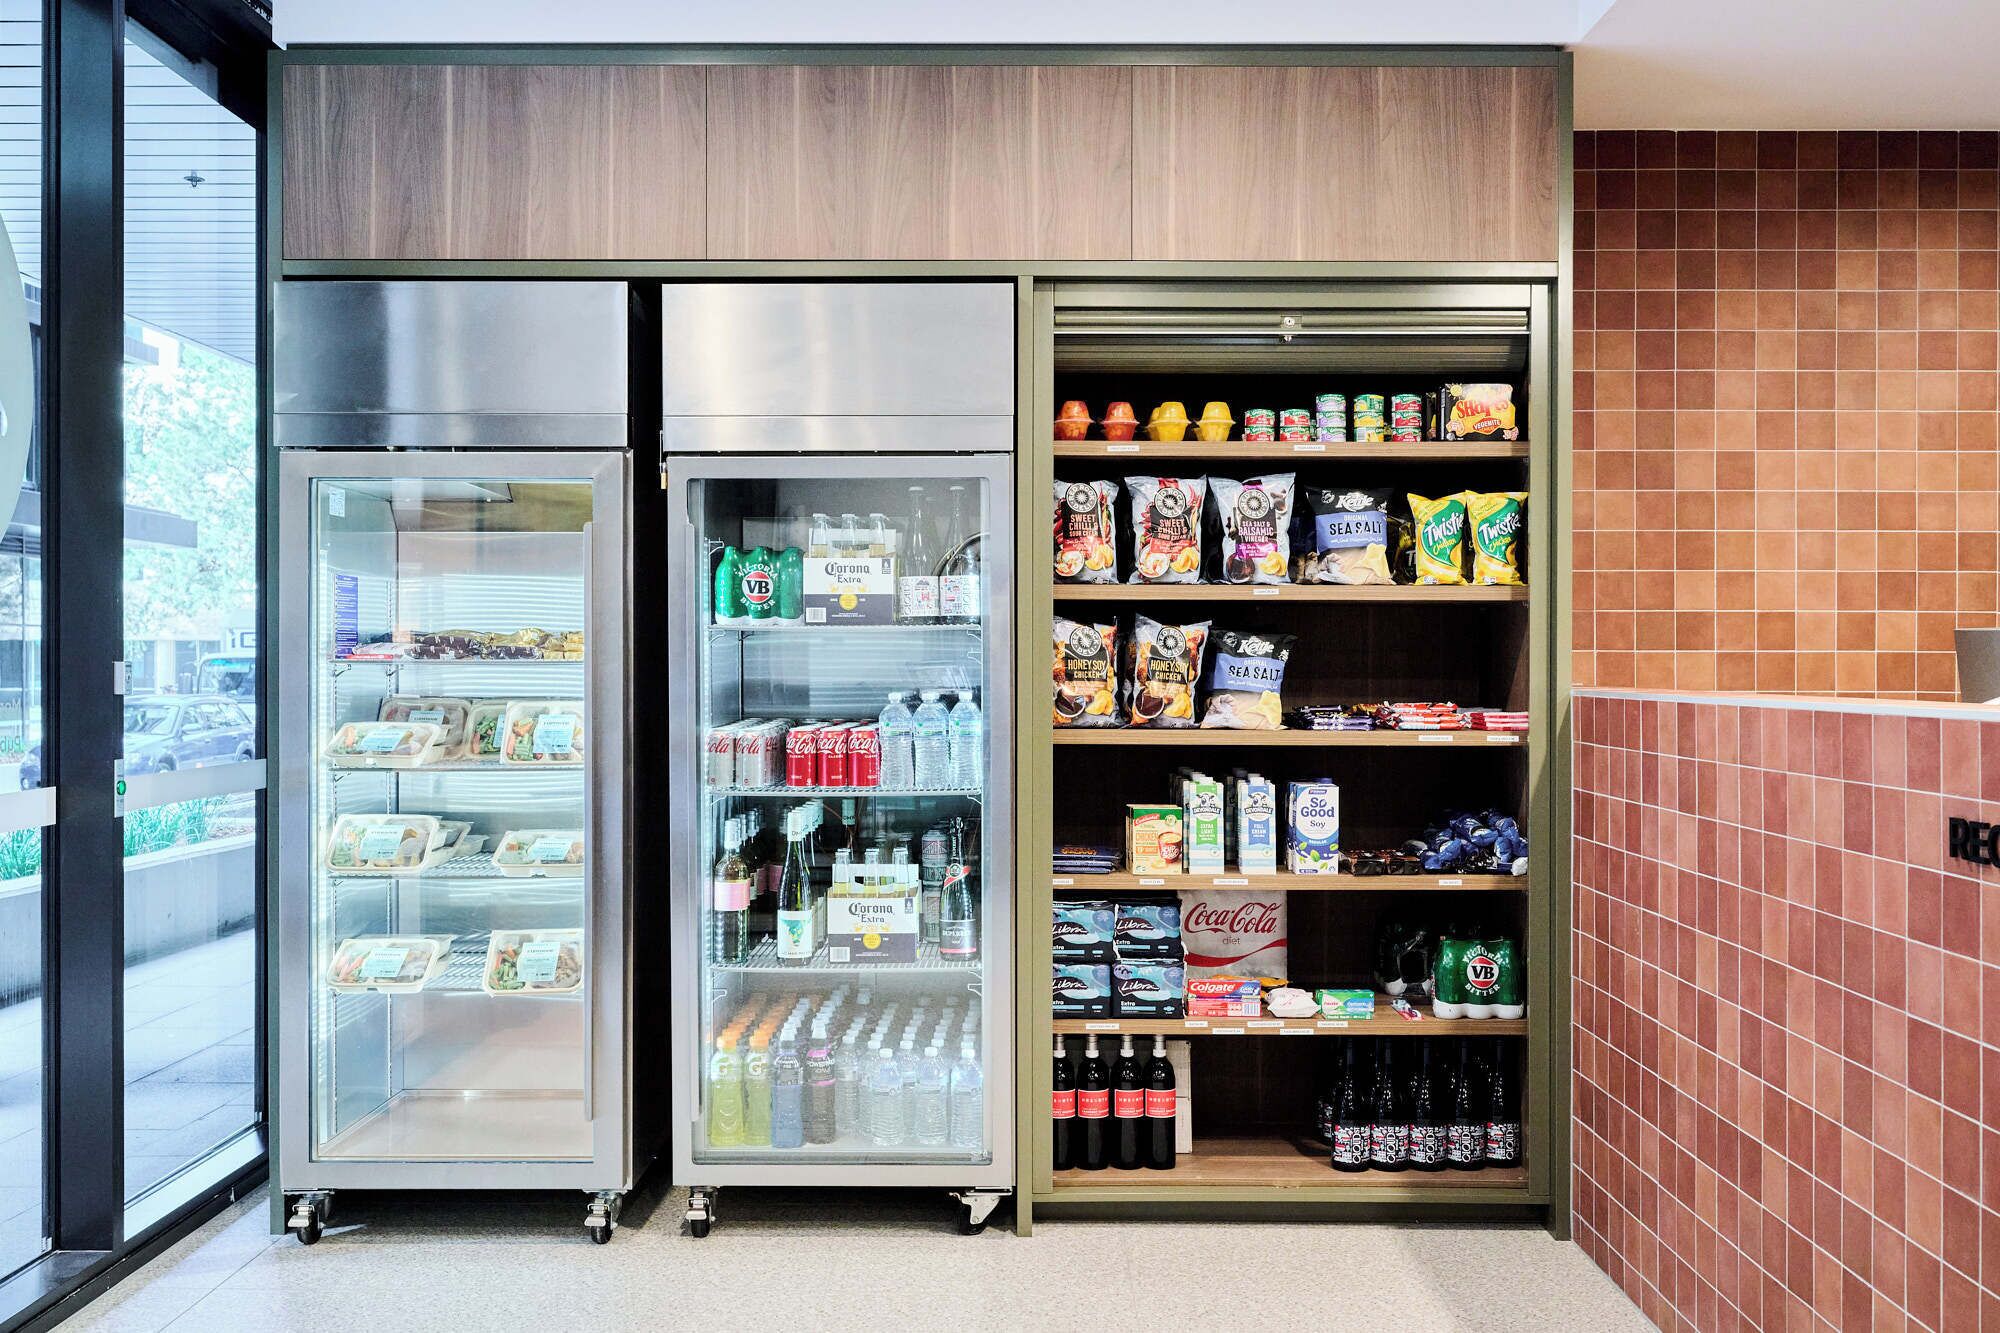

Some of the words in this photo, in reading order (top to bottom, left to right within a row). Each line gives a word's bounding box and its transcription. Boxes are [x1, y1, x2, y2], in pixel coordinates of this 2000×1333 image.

[1070, 514, 1096, 523] SWEET
[1160, 519, 1185, 528] SWEET
[1069, 522, 1089, 531] CHILLI
[1238, 527, 1274, 536] BALSAMIC
[1329, 523, 1352, 535] SEA
[1355, 521, 1382, 535] SALT
[738, 563, 778, 579] VICTORIA
[824, 561, 870, 577] Corona
[837, 574, 862, 584] Extra
[745, 580, 770, 594] VB
[740, 597, 776, 611] BITTER
[1068, 659, 1092, 670] HONEY
[1093, 660, 1107, 671] SOY
[1150, 660, 1174, 672] HONEY
[1175, 662, 1189, 673] SOY
[1074, 671, 1100, 679] CHICKEN
[1155, 672, 1182, 681] CHICKEN
[1228, 665, 1250, 678] SEA
[1253, 667, 1281, 681] SALT
[1310, 797, 1327, 808] So
[1300, 806, 1335, 818] Good
[1310, 820, 1326, 829] Soy
[848, 902, 893, 916] Corona
[861, 914, 885, 923] Extra
[1052, 924, 1088, 934] Libra
[1116, 920, 1154, 929] Libra
[1222, 936, 1241, 945] diet
[1462, 945, 1504, 966] VICTORIA
[1471, 965, 1495, 979] VB
[1052, 979, 1088, 989] Libra
[1121, 981, 1160, 991] Libra
[1190, 982, 1235, 993] Colgate
[1465, 983, 1501, 997] BITTER
